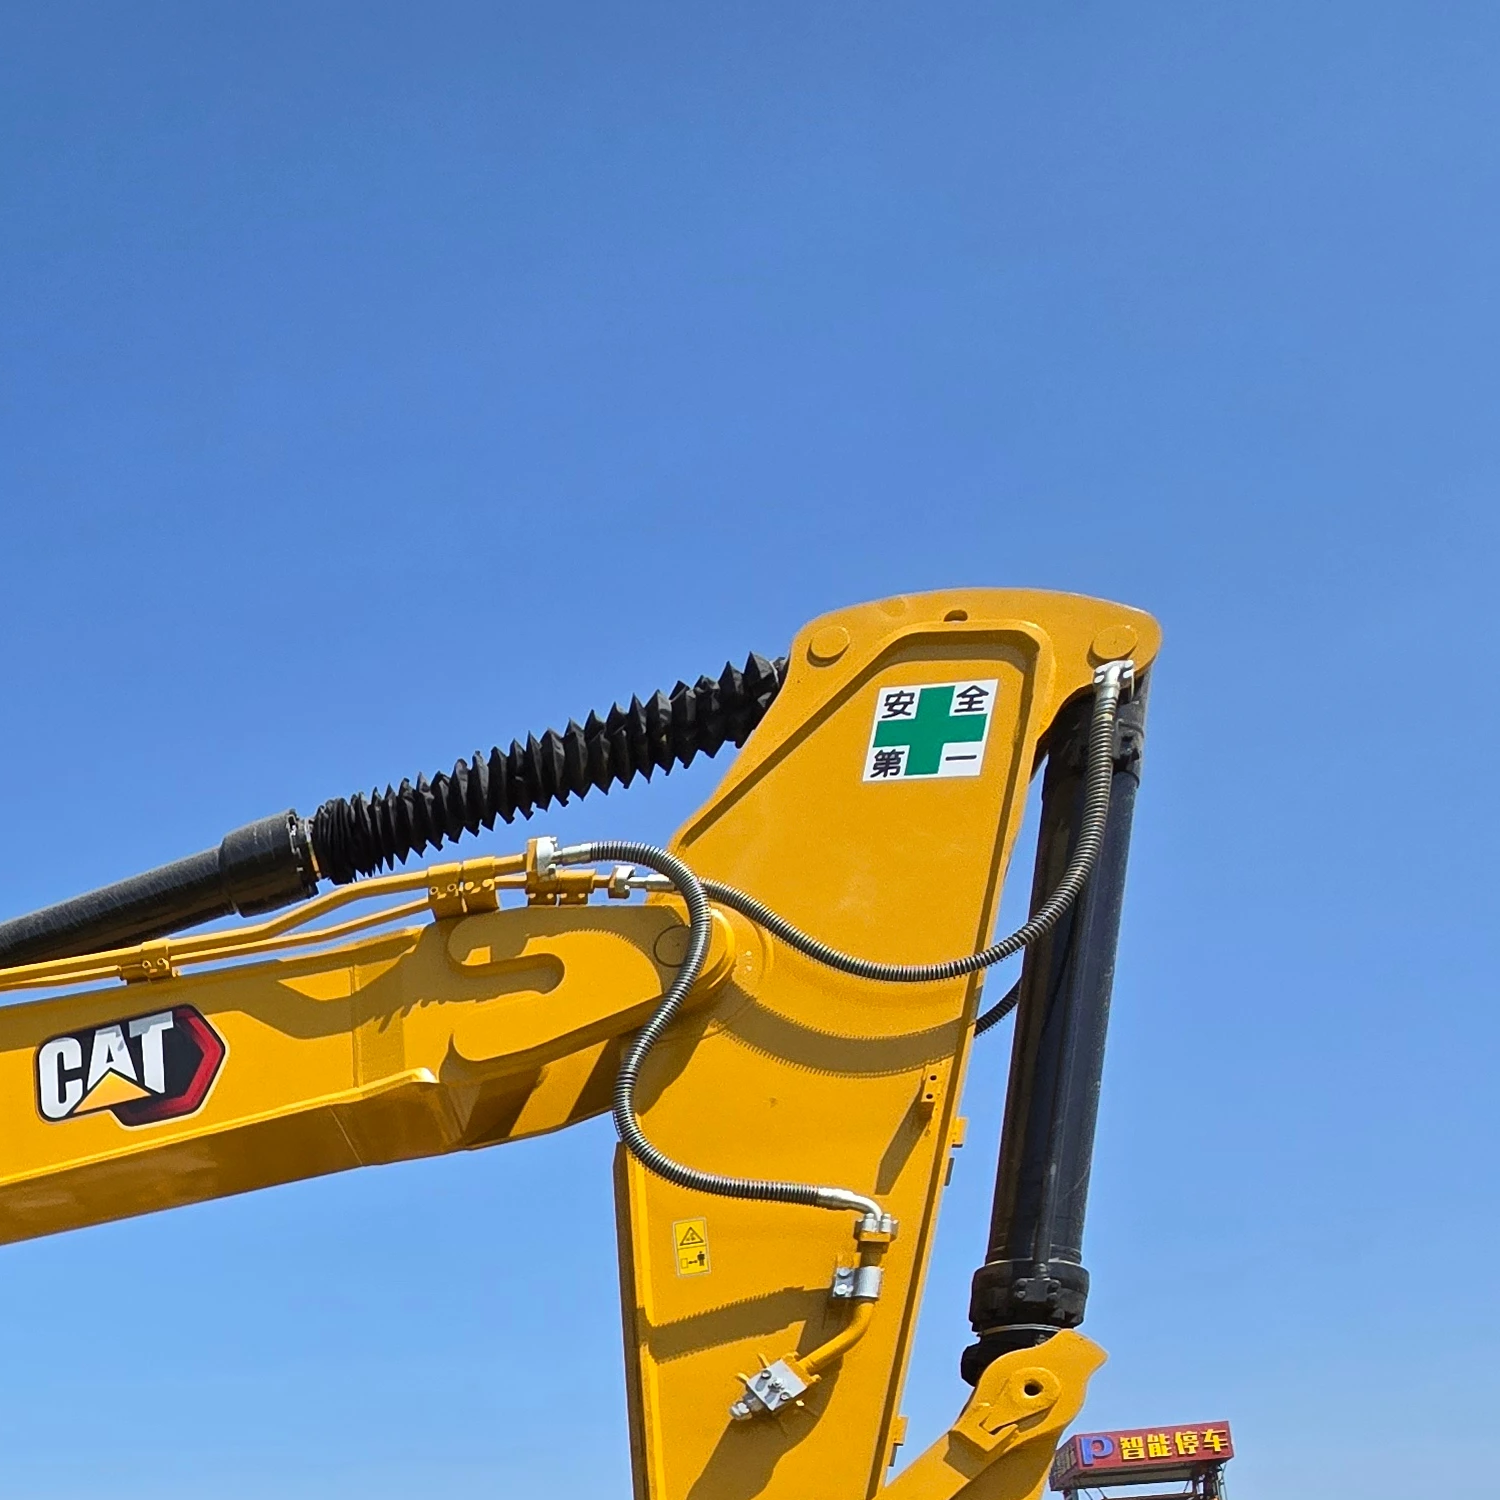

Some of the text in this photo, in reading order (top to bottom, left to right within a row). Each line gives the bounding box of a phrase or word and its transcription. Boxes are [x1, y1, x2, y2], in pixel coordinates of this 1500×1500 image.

[38, 1011, 174, 1109] CAT
[1119, 1428, 1229, 1461] 智能停车
